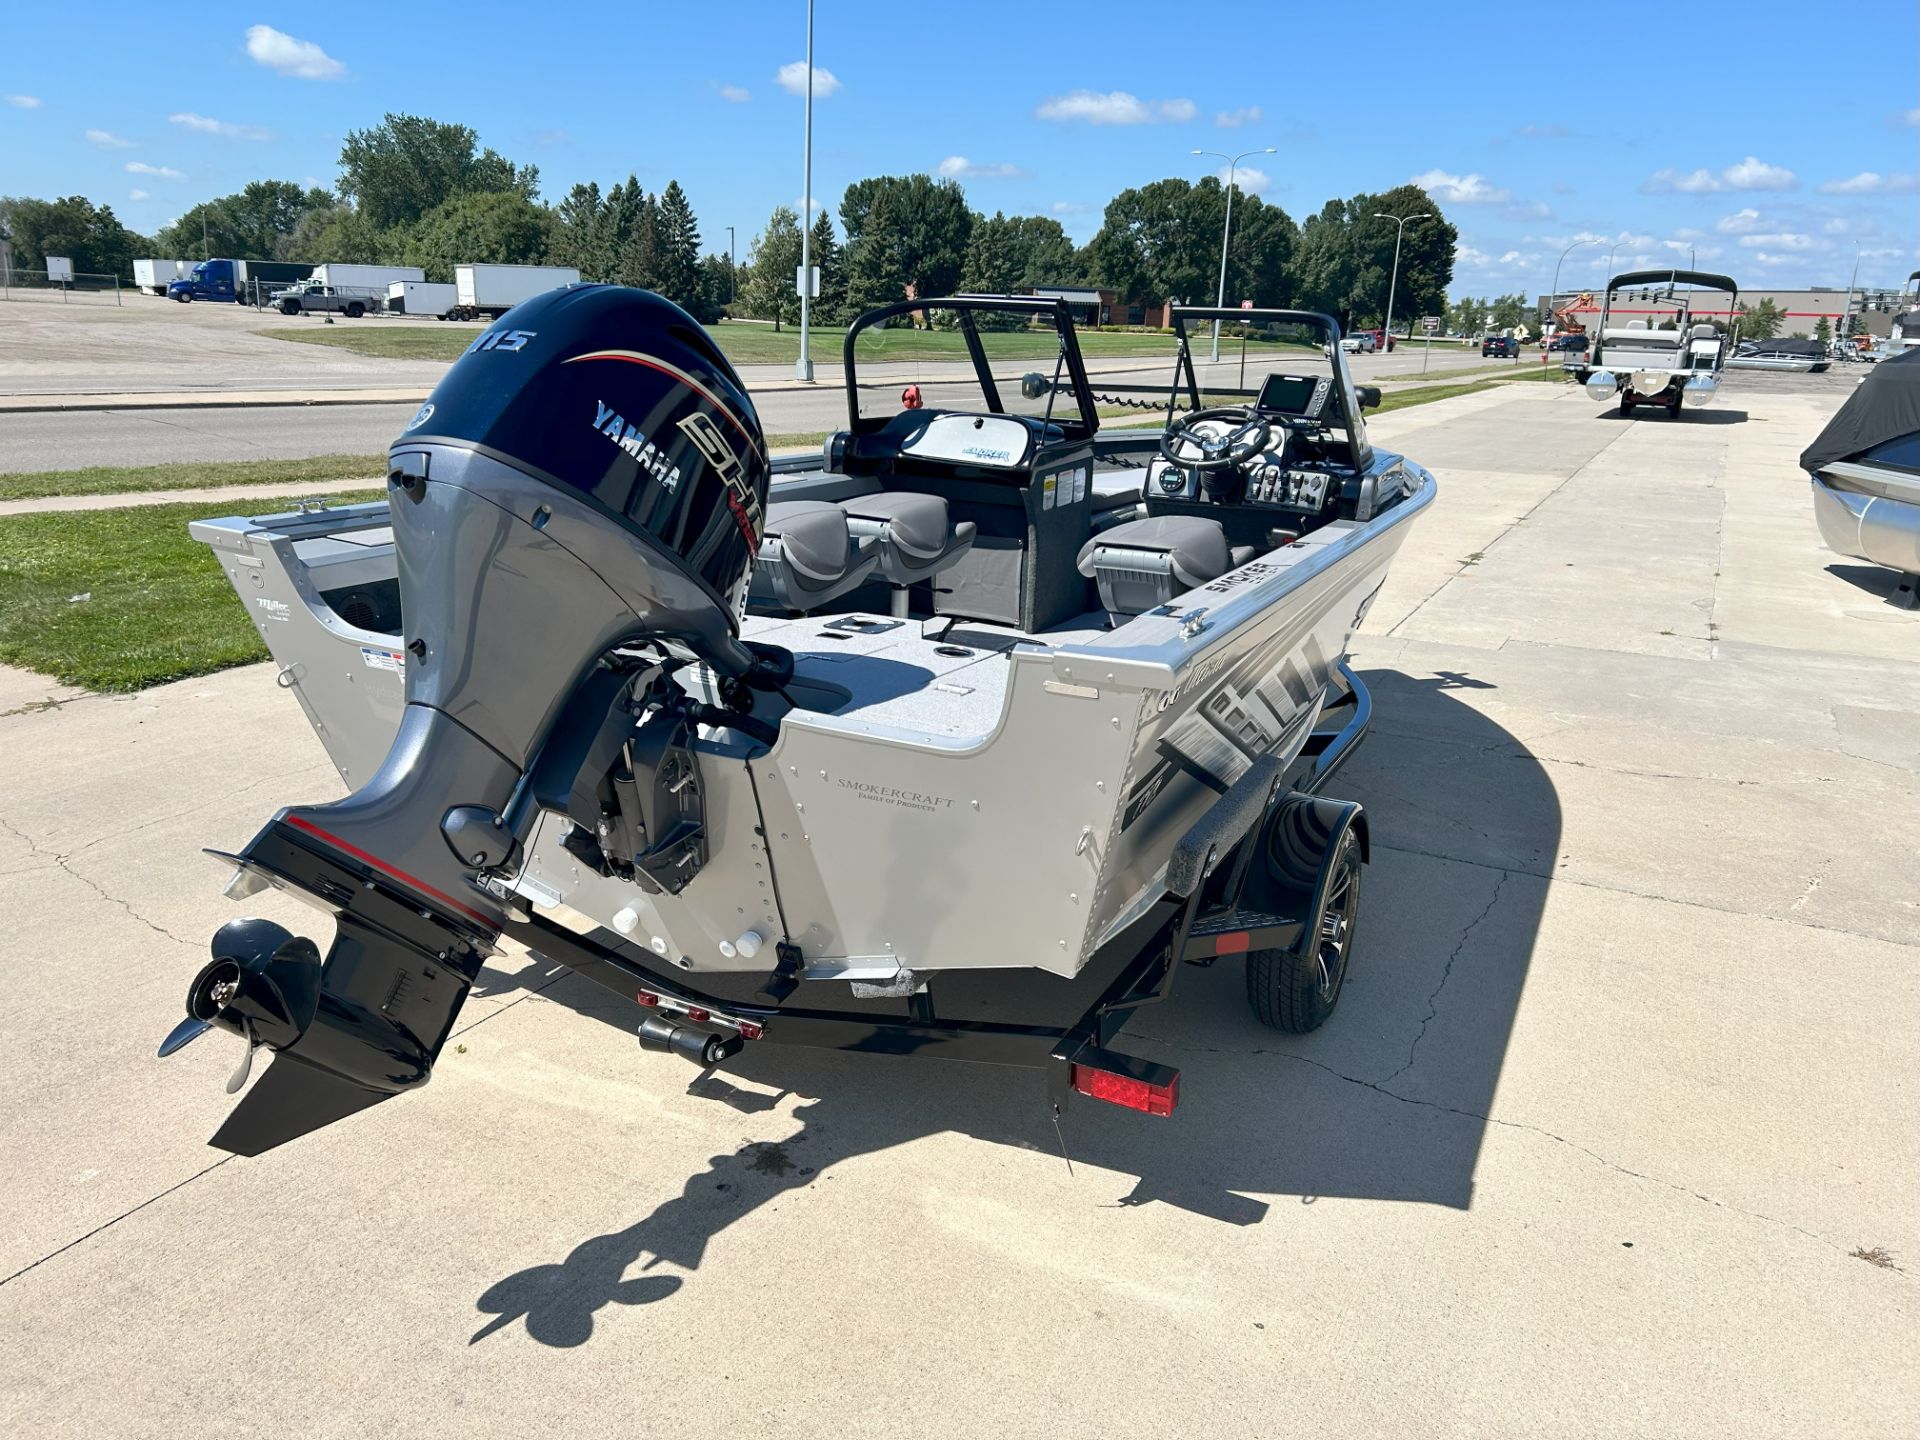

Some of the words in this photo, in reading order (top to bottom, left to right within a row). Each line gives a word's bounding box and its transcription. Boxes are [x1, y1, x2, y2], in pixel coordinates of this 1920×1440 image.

[468, 329, 538, 353] 115
[592, 399, 681, 495] YAMAHA
[1204, 562, 1270, 593] SMOKER
[837, 778, 956, 808] SMOKERCRAFT
